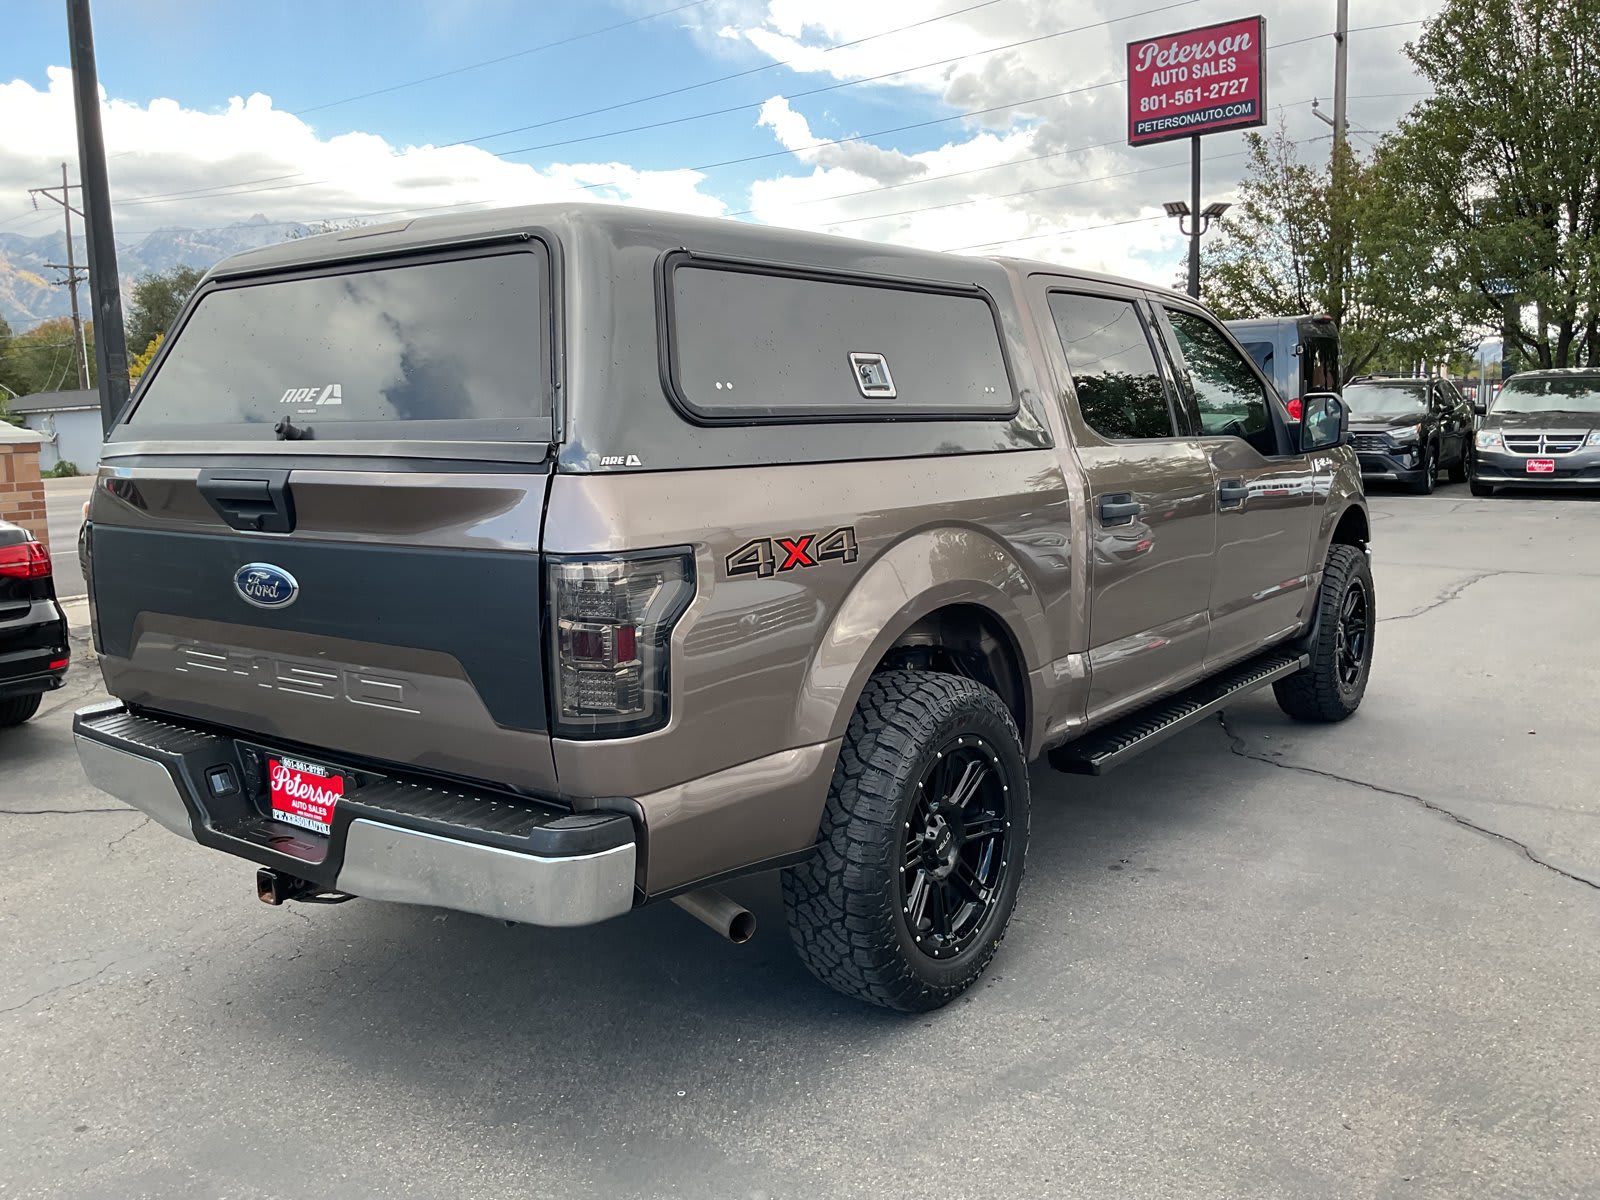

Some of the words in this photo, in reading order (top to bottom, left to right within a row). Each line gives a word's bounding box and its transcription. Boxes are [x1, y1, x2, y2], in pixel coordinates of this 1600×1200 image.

[1136, 33, 1252, 72] Peterson
[1151, 66, 1188, 87] AUTO
[1192, 57, 1236, 79] SALES
[1140, 78, 1249, 112] 801-561-2727
[1138, 103, 1251, 133] PETERSONAUTO.COM
[245, 572, 279, 598] Ford
[291, 800, 308, 811] AUTO
[308, 803, 327, 816] SALES
